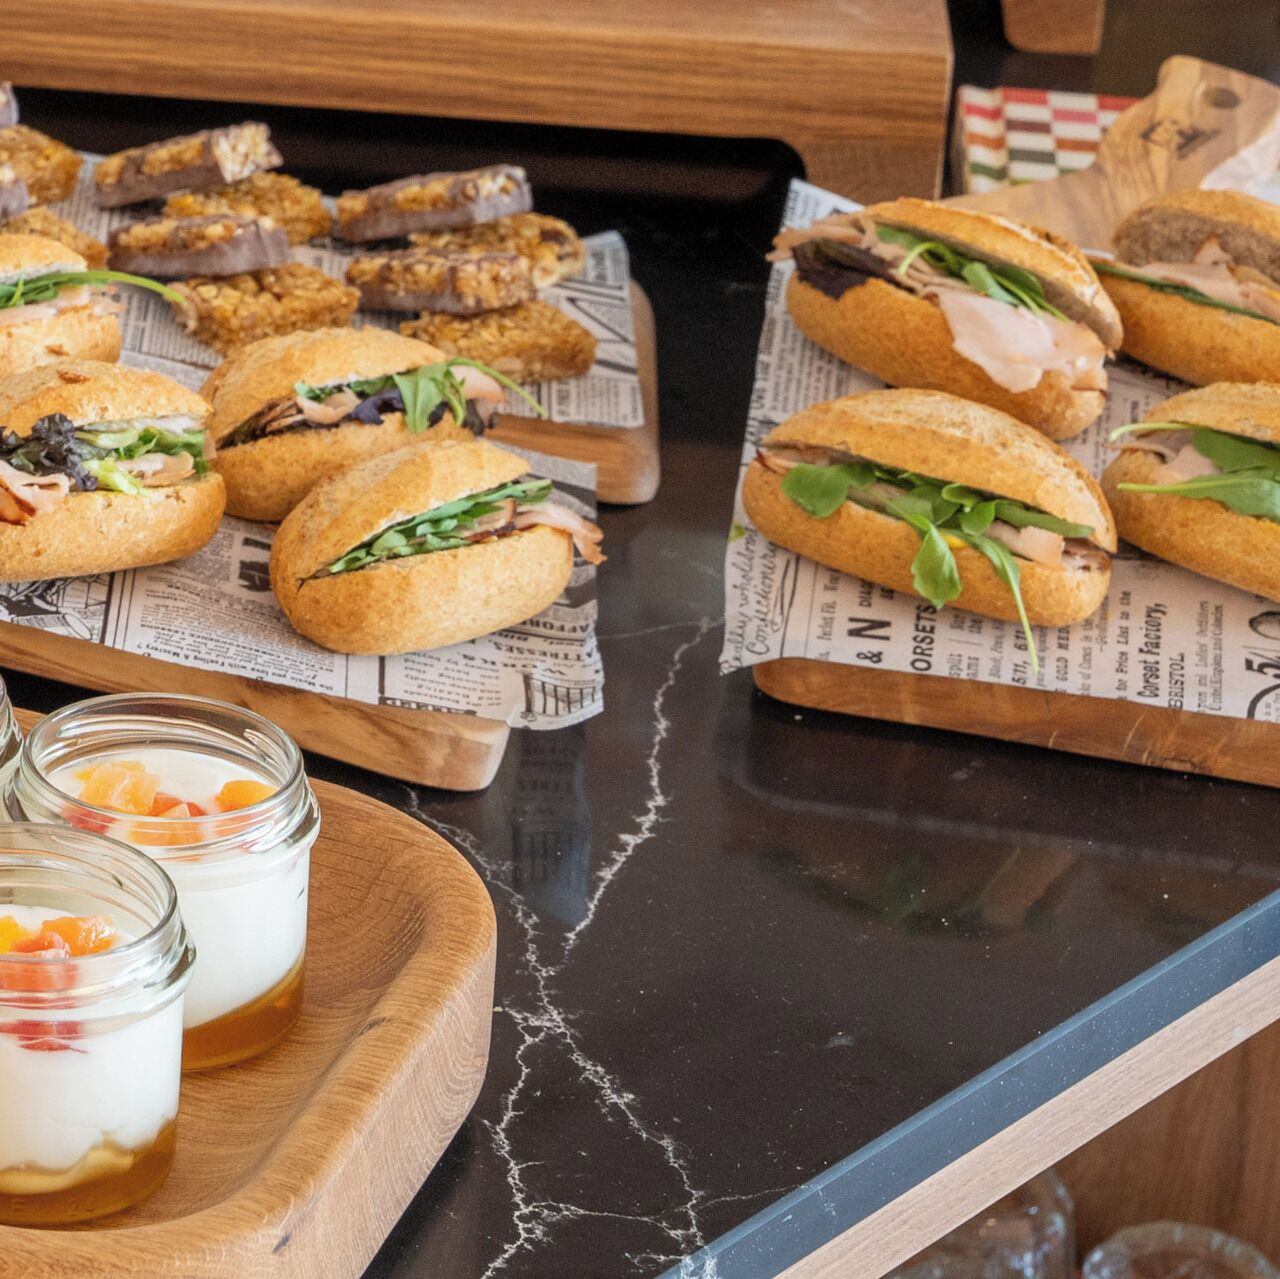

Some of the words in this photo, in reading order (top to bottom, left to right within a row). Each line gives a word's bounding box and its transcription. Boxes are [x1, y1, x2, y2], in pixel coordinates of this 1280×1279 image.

[1119, 591, 1132, 606] the
[847, 617, 891, 641] N
[1116, 625, 1129, 645] List
[1139, 602, 1167, 656] Factory,
[856, 650, 883, 663] &
[1115, 651, 1128, 674] Price
[1055, 657, 1068, 681] GOLD
[1136, 659, 1161, 698] Corset
[1115, 679, 1128, 691] for
